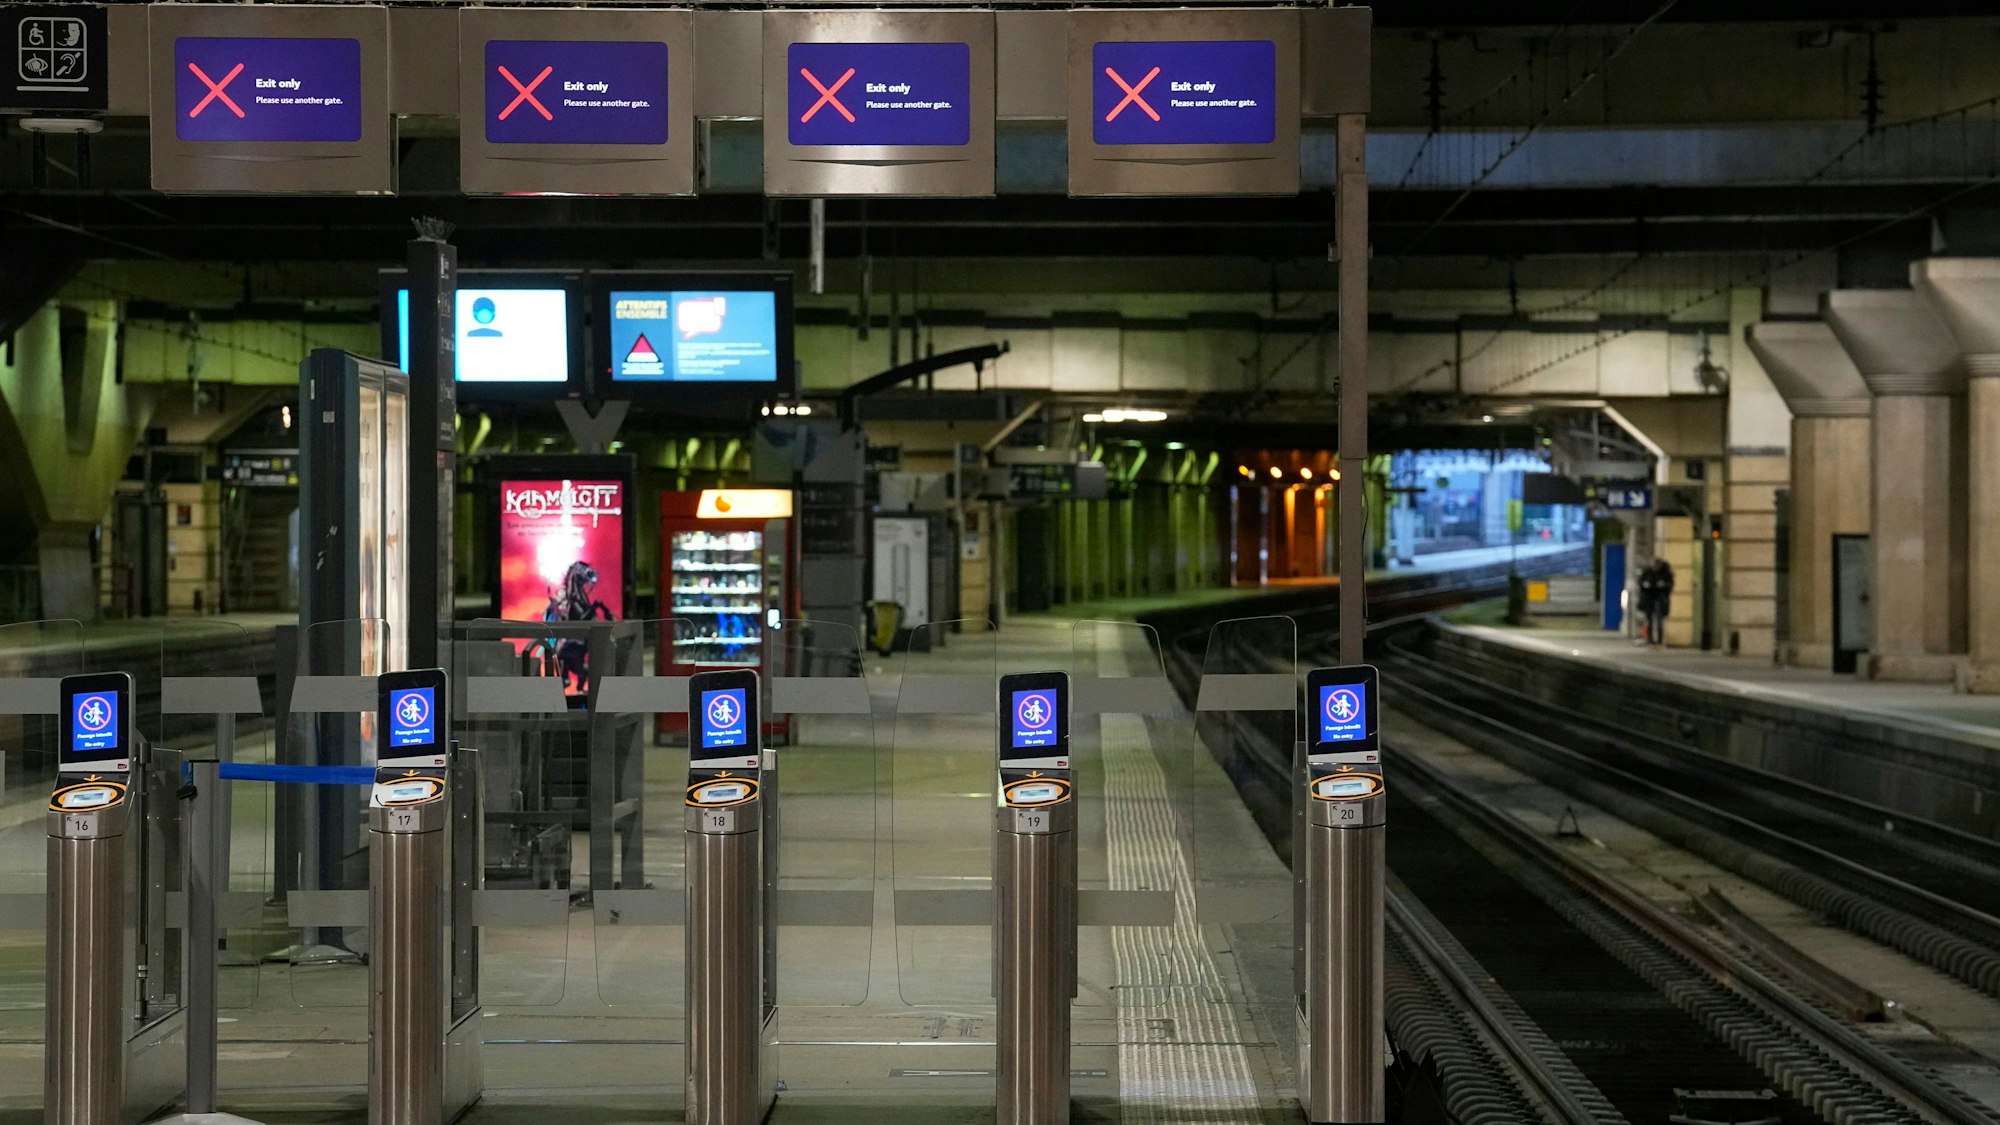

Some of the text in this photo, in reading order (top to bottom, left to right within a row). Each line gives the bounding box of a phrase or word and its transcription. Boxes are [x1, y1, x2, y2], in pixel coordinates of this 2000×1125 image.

[256, 79, 301, 91] Exit only
[564, 81, 608, 93] Exit only
[866, 82, 910, 95] Exit only
[1171, 81, 1215, 93] Exit only
[256, 96, 279, 104] Please
[325, 98, 343, 106] gate.
[564, 99, 587, 107] Please
[602, 99, 630, 107] another
[632, 100, 649, 108] gate.
[866, 100, 889, 109] Please
[934, 102, 951, 110] gate.
[1171, 99, 1194, 107] Please
[1209, 99, 1238, 107] another
[1239, 100, 1257, 108] gate.
[1341, 809, 1354, 820] 20
[76, 820, 89, 831] 16
[398, 815, 411, 826] 17
[712, 816, 725, 827] 18
[1027, 816, 1040, 828] 19
